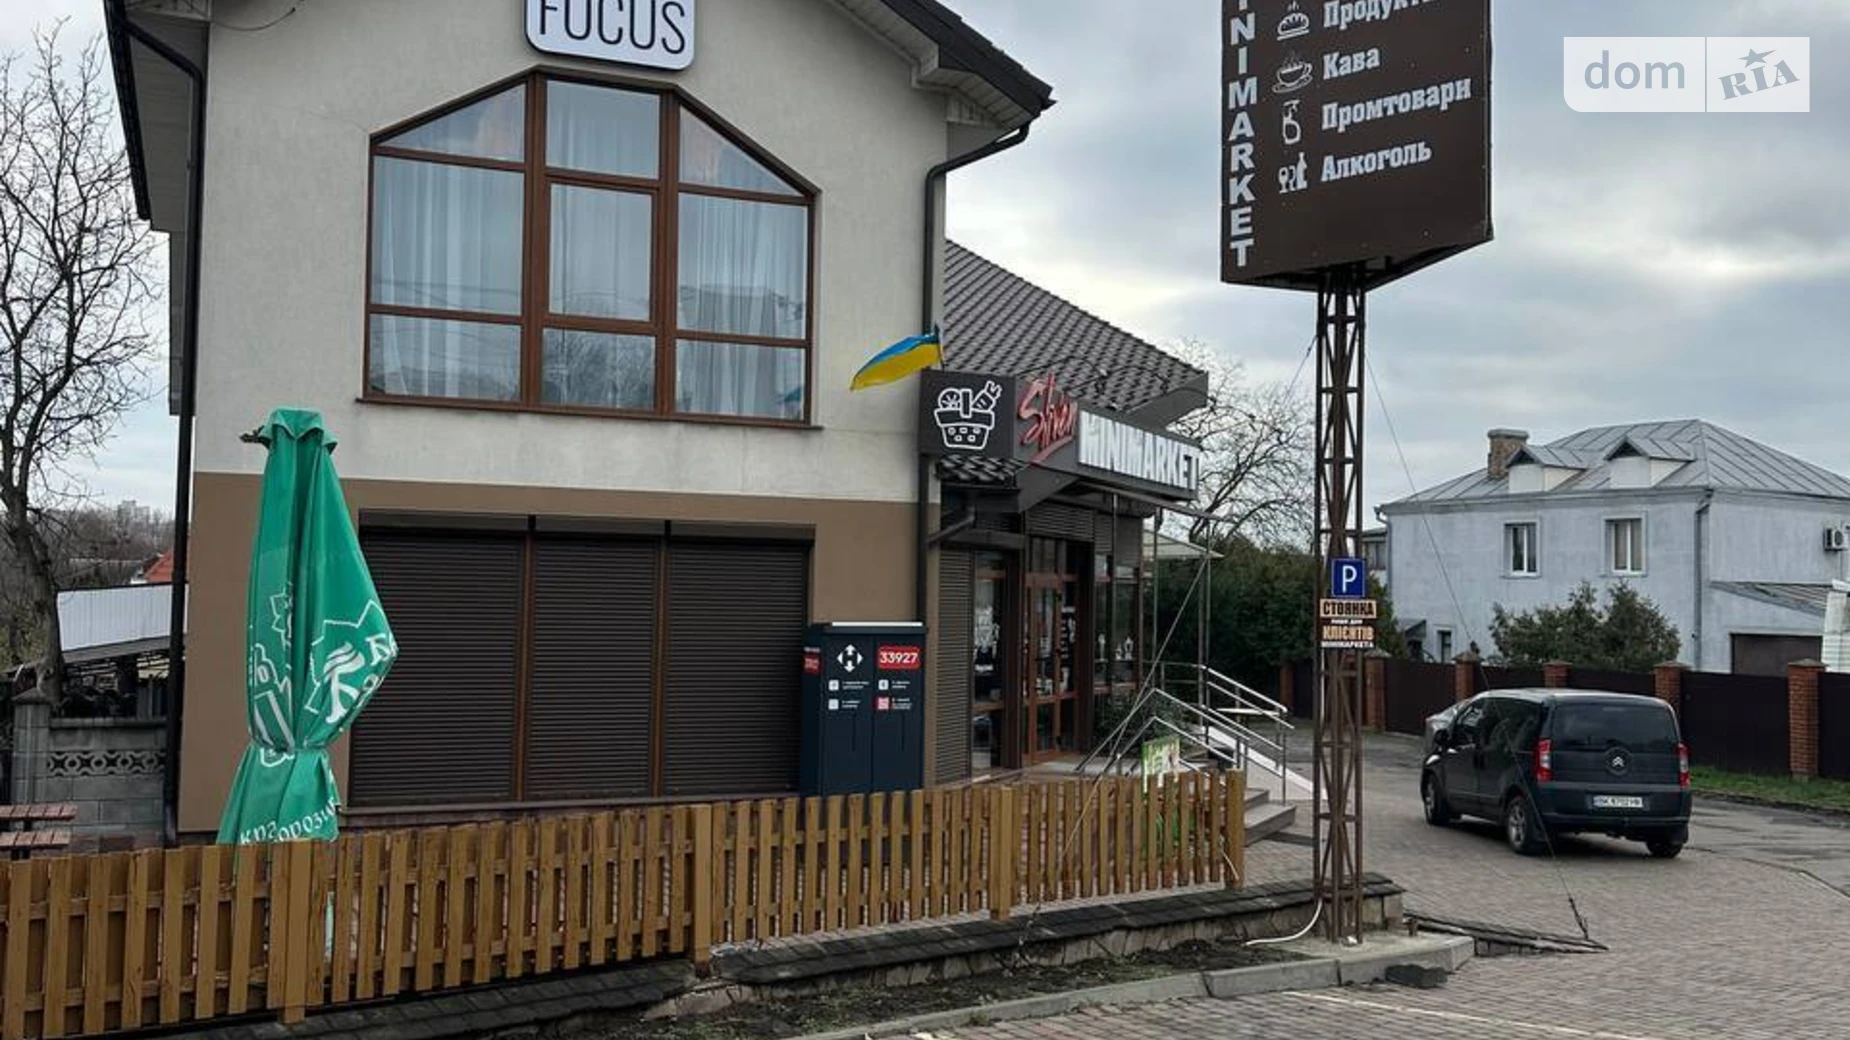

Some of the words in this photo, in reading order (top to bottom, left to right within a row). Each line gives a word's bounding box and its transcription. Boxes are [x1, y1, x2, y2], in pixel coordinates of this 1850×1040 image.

[540, 0, 686, 54] FOCUS
[1322, 47, 1380, 80] Кава
[1320, 141, 1432, 182] Алкоголь
[1079, 409, 1200, 490] MINIMARKET
[1342, 565, 1357, 593] P
[1323, 601, 1374, 616] СТОЯНКА
[880, 652, 918, 664] 33927
